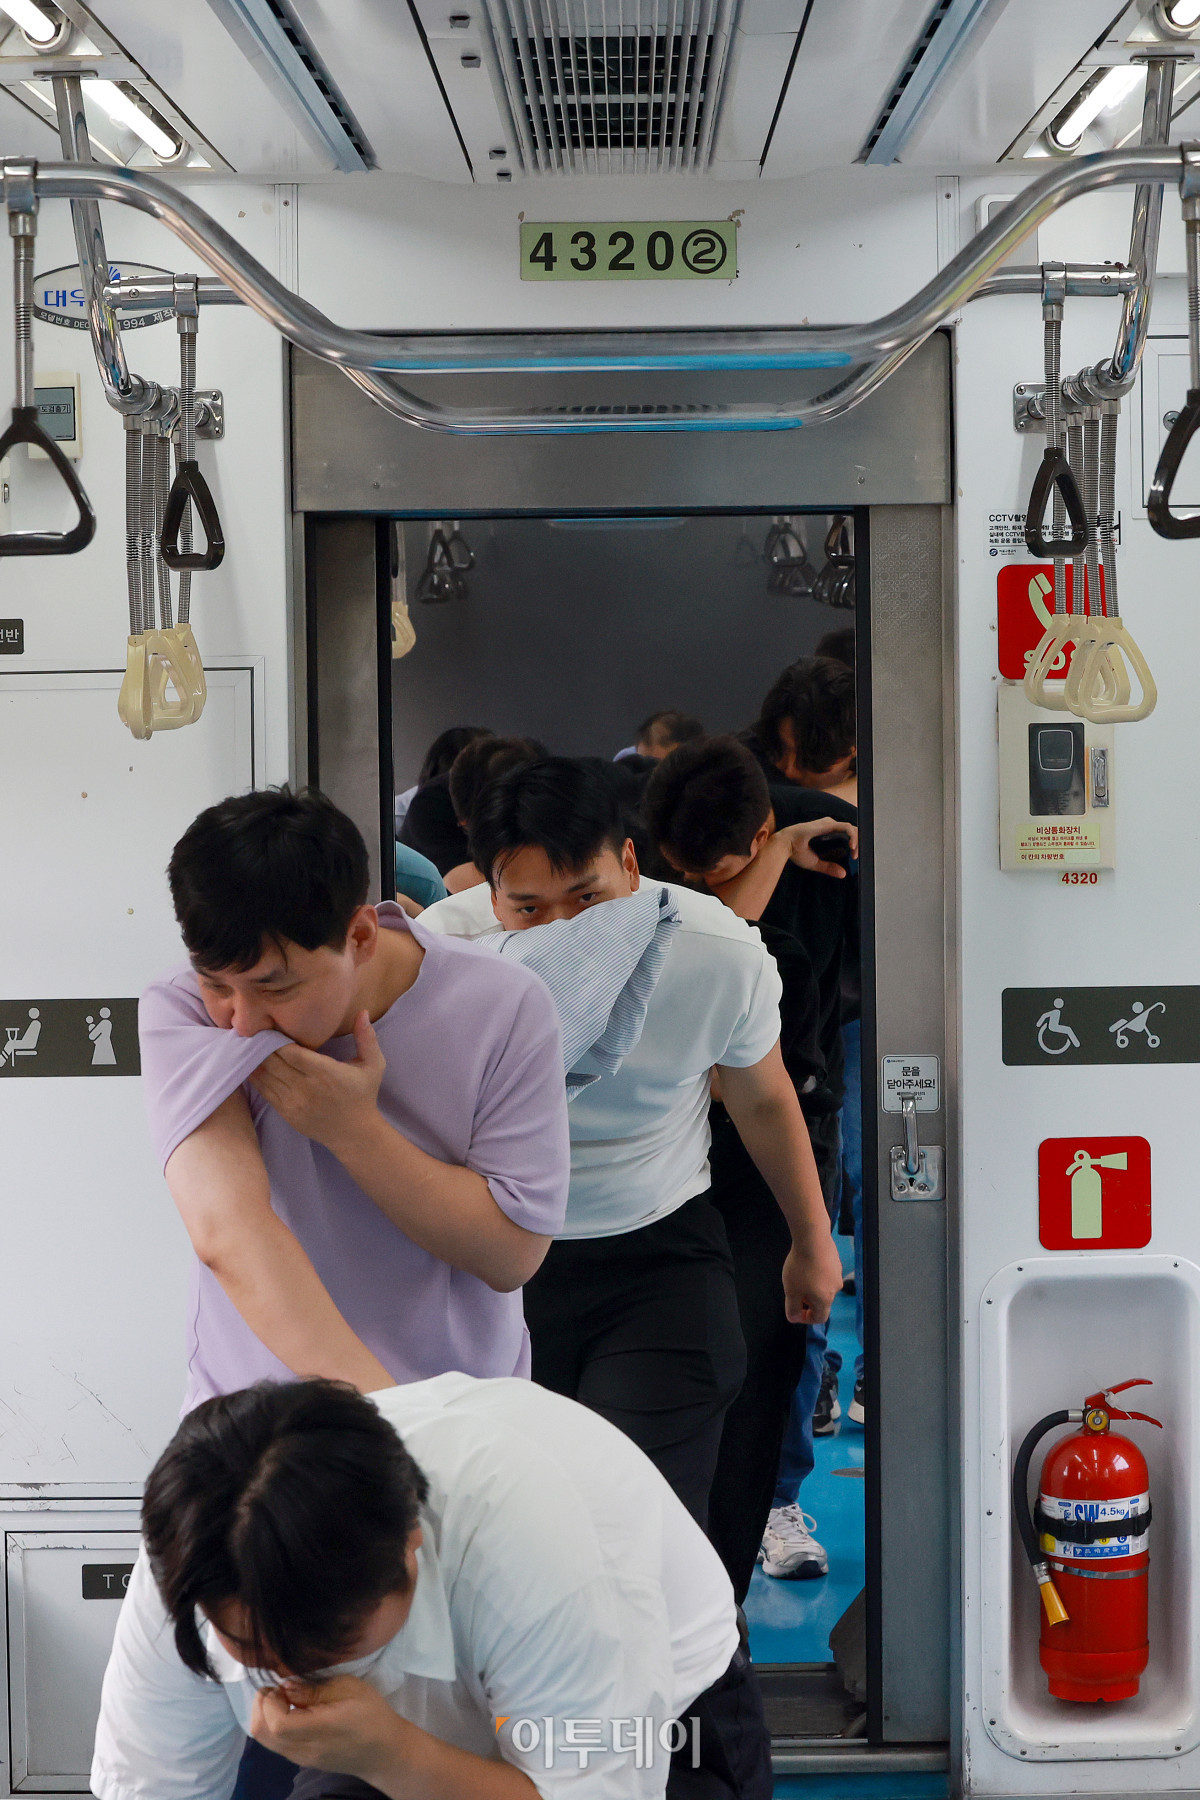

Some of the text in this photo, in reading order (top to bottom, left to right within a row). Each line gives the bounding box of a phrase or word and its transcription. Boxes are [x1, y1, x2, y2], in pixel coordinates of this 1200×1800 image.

[40, 311, 71, 327] 모델번호
[152, 307, 175, 324] 제작
[1036, 826, 1081, 835] 비상통화장치
[1061, 872, 1098, 885] 4320
[901, 1066, 921, 1077] 문을
[887, 1079, 936, 1090] 닫아주세요!
[1100, 1507, 1125, 1516] 4.5kg
